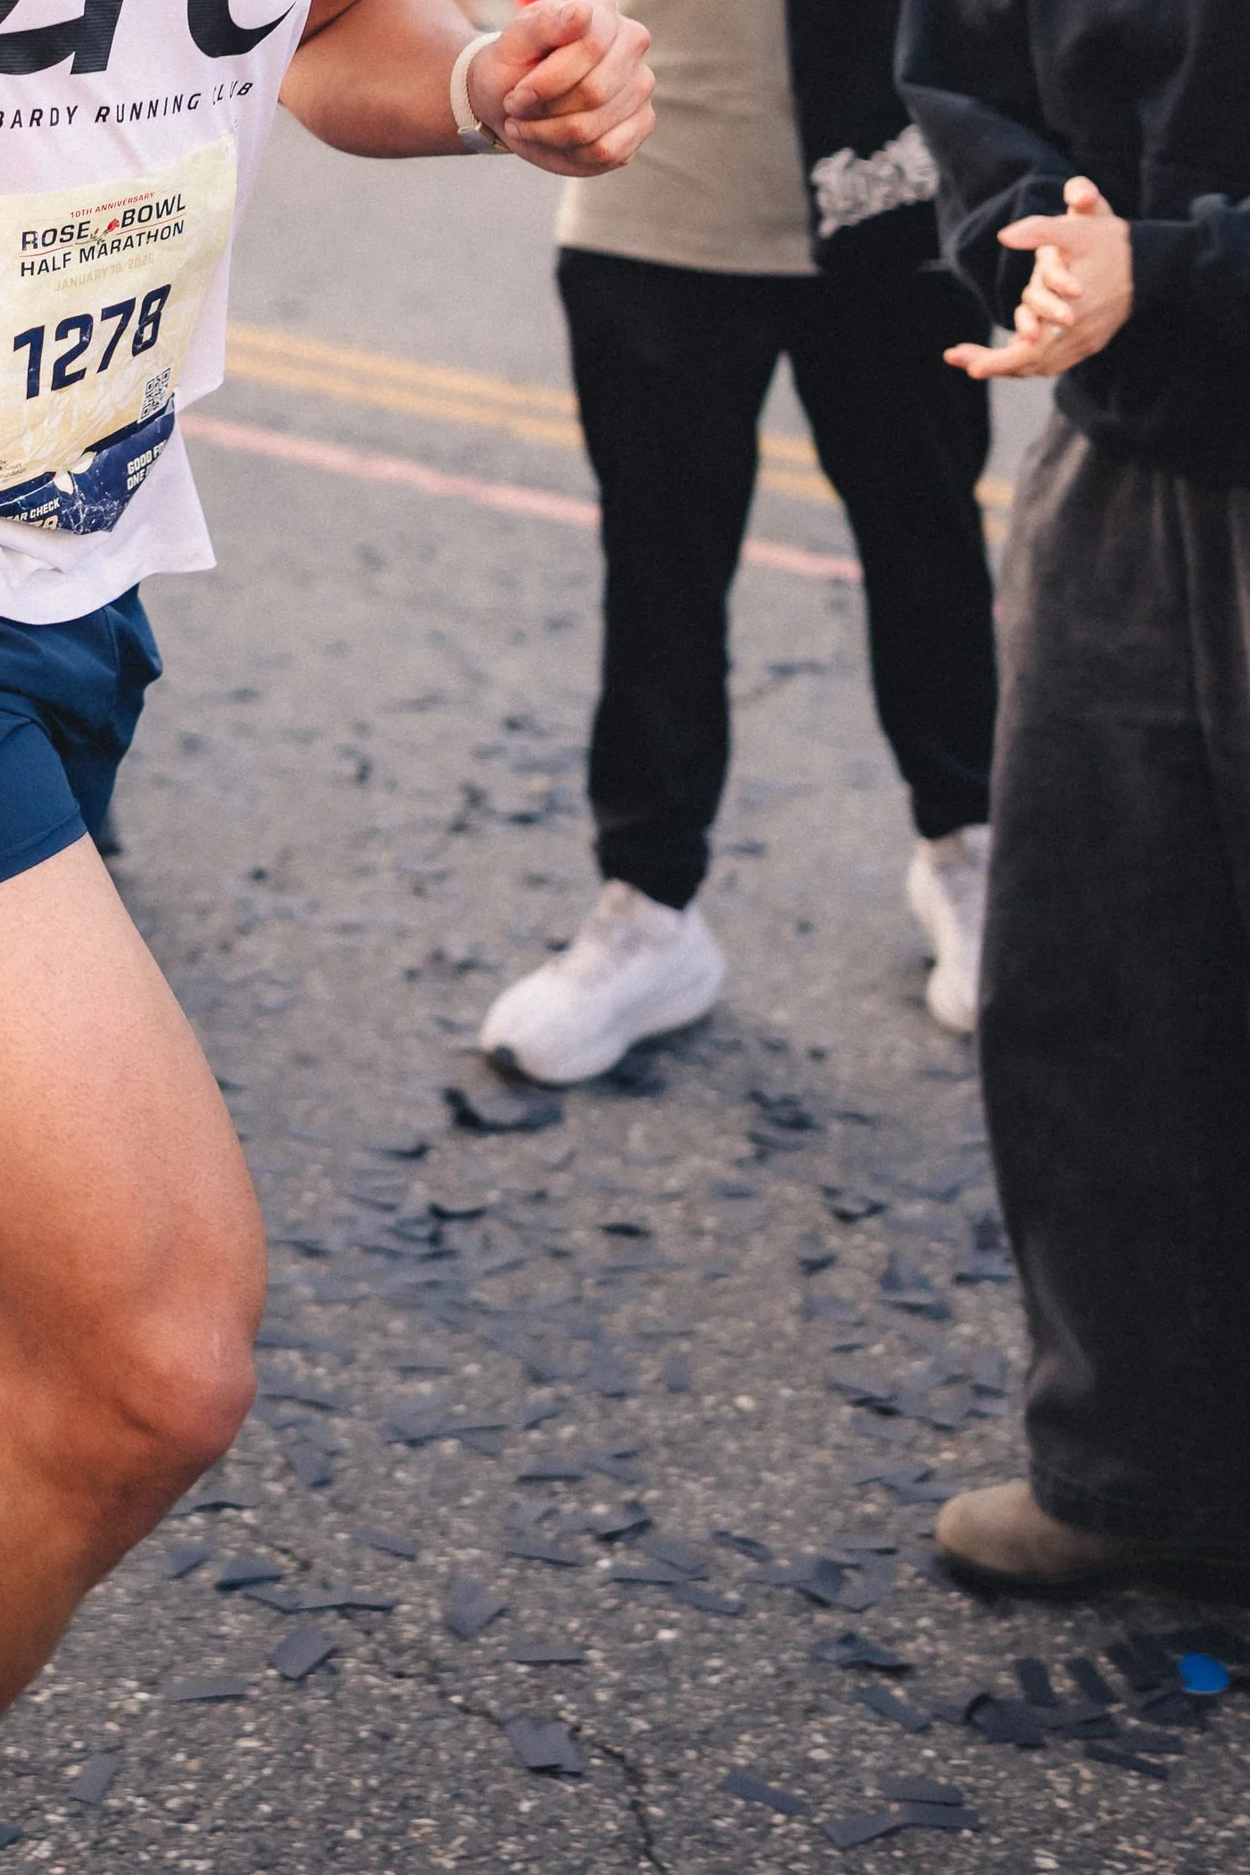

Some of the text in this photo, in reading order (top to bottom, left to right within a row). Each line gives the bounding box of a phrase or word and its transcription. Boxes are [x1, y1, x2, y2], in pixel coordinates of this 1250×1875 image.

[94, 92, 202, 124] RUNNING
[70, 191, 155, 219] 10TH ANNIVERSARY
[21, 193, 186, 251] ROSE BOWL
[20, 219, 185, 277] HALF MARATHON
[53, 266, 108, 292] JANUARY
[13, 283, 172, 400] 1278
[127, 449, 153, 476] GOOD
[126, 468, 146, 491] ONE
[29, 497, 61, 519] CHECK
